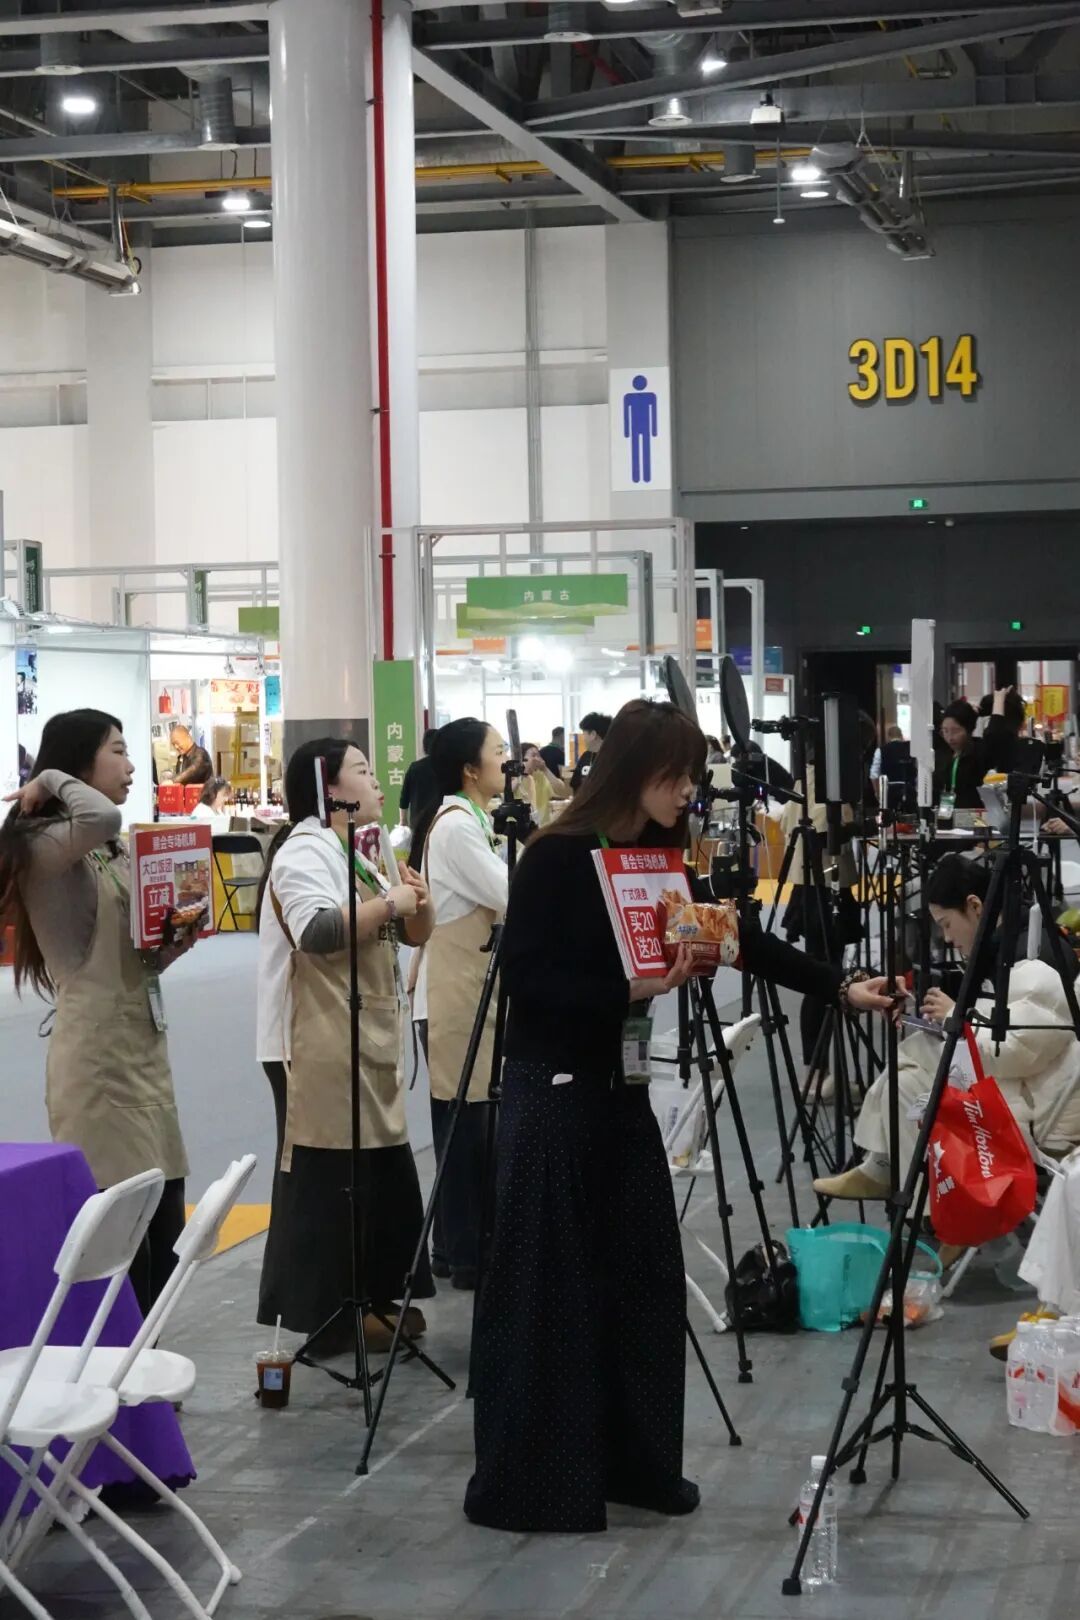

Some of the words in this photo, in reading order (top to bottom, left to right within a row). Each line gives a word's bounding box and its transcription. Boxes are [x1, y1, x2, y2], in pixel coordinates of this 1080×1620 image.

[848, 335, 977, 400] 3D14
[524, 590, 570, 601] 内蒙古
[387, 722, 404, 785] 内蒙古
[142, 858, 172, 875] 大口饭团
[148, 885, 171, 908] 立减
[628, 911, 654, 933] 买20
[636, 936, 662, 958] 送20
[963, 1100, 983, 1125] Tim
